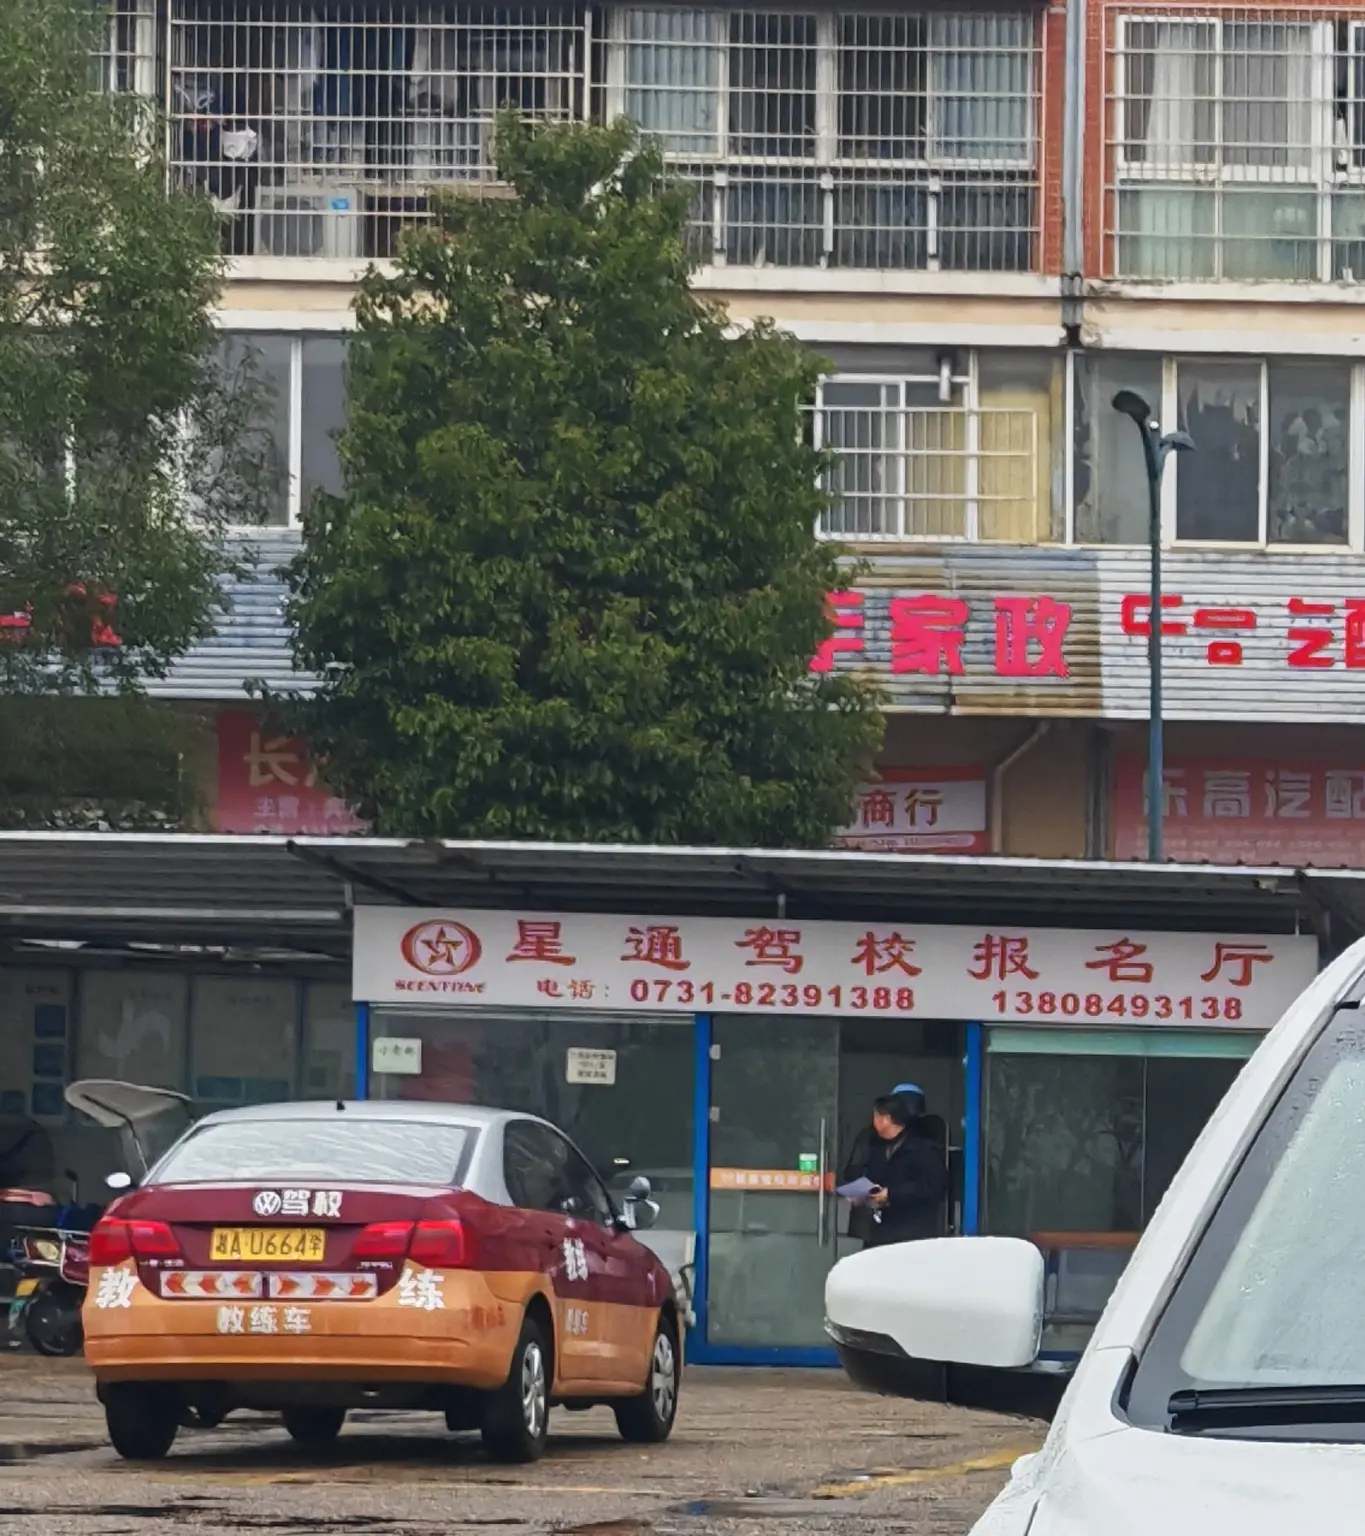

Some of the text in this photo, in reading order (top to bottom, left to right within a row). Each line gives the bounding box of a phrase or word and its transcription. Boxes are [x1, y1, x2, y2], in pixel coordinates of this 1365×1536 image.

[506, 920, 1275, 987] 星通驾校报名厅
[630, 980, 916, 1010] 0731-82391388
[992, 990, 1243, 1020] 13808493138
[281, 1190, 342, 1217] 驾校
[399, 1268, 446, 1311] 练
[217, 1306, 313, 1334] 教练车
